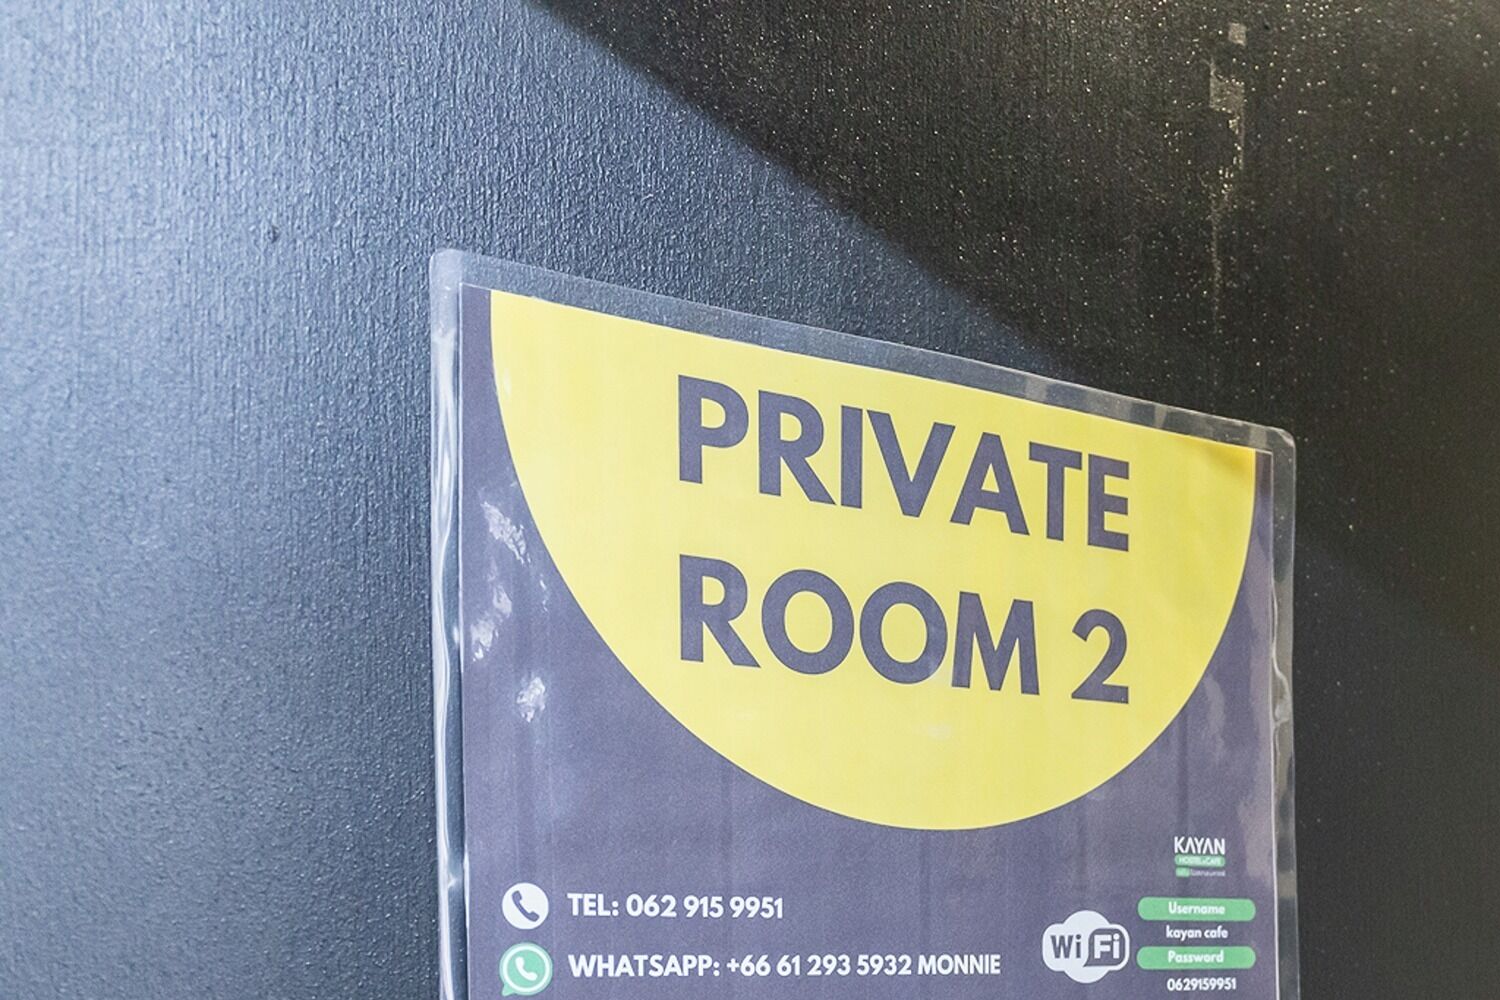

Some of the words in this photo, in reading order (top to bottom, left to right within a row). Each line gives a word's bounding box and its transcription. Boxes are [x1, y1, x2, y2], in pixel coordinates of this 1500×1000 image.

[678, 375, 1130, 552] PRIVATE
[679, 554, 1040, 697] ROOM
[1070, 608, 1130, 704] 2
[1174, 836, 1226, 855] KAYAN
[567, 893, 619, 917] TEL:
[626, 894, 676, 918] 062
[683, 896, 723, 919] 915
[729, 897, 783, 919] 9951
[1168, 901, 1226, 915] Username
[1165, 926, 1202, 942] kayan
[1204, 926, 1229, 939] cafe
[567, 954, 721, 978] WHATSAPP:
[726, 954, 771, 976] +66
[777, 954, 800, 976] 61
[806, 954, 851, 976] 293
[856, 954, 911, 976] 5932
[917, 953, 1001, 975] MONNIE
[1167, 949, 1225, 964] Password
[1166, 977, 1237, 992] 0629159951
